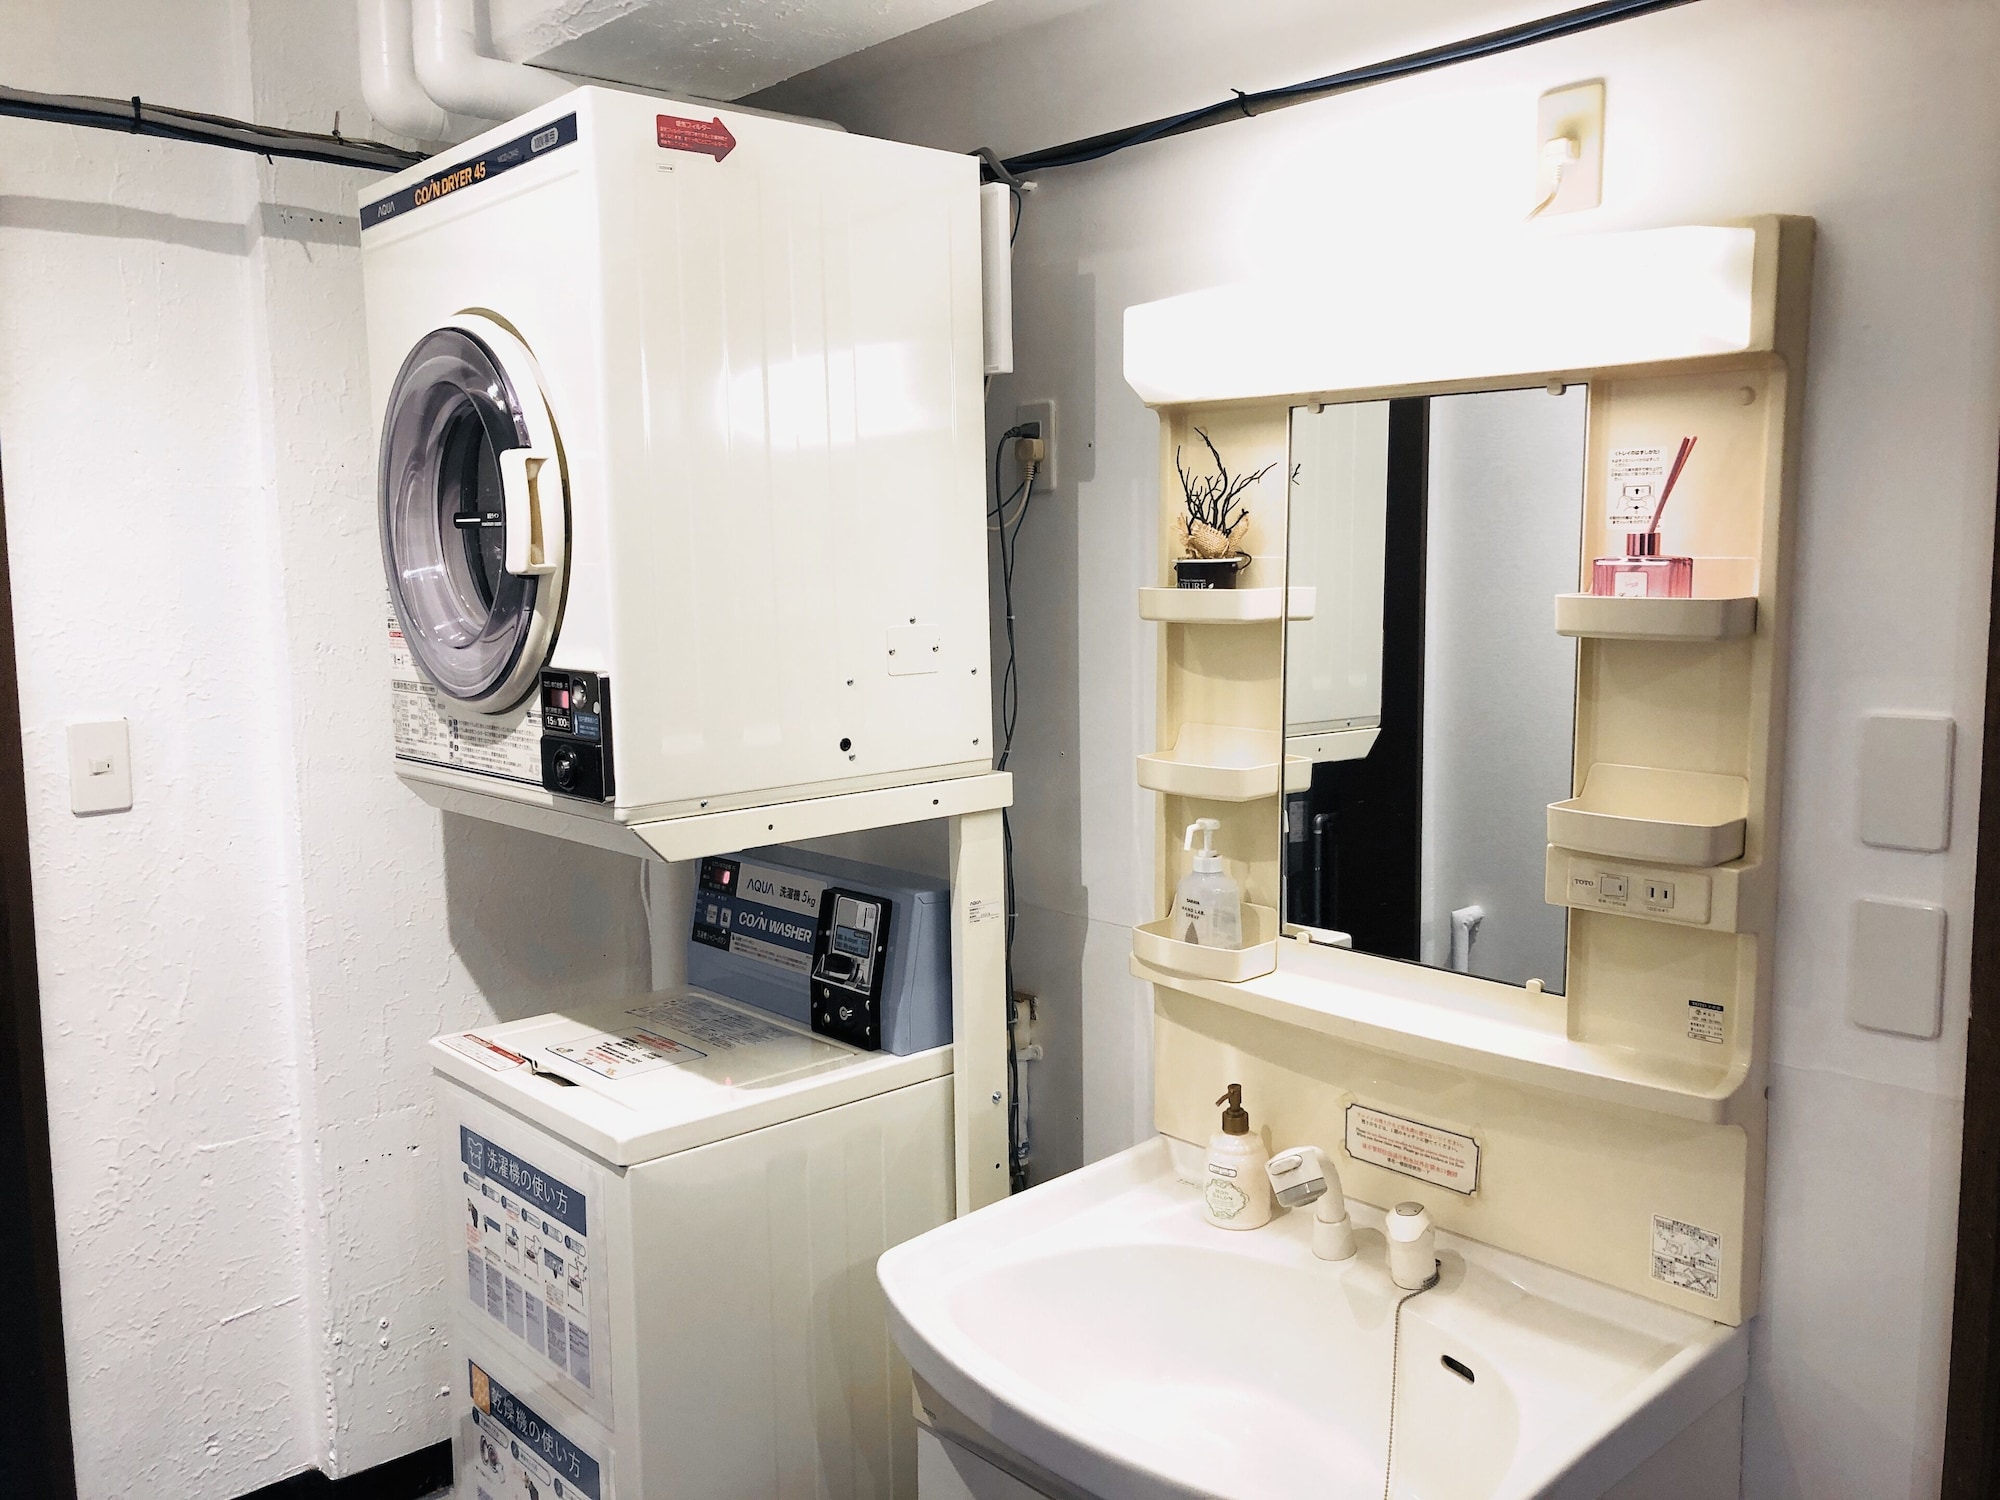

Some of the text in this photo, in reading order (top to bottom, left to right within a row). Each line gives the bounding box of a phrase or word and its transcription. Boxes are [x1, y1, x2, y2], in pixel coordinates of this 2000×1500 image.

[377, 161, 486, 218] AQUA COIN DRYER 45
[746, 878, 816, 908] AQUA 洗濯機 5kg
[1574, 878, 1594, 887] TOTO
[739, 911, 768, 931] COIN
[769, 919, 813, 943] WASHER
[486, 1146, 569, 1215] 洗濯機の使い方
[491, 1387, 580, 1478] 乾燥機の使い方
